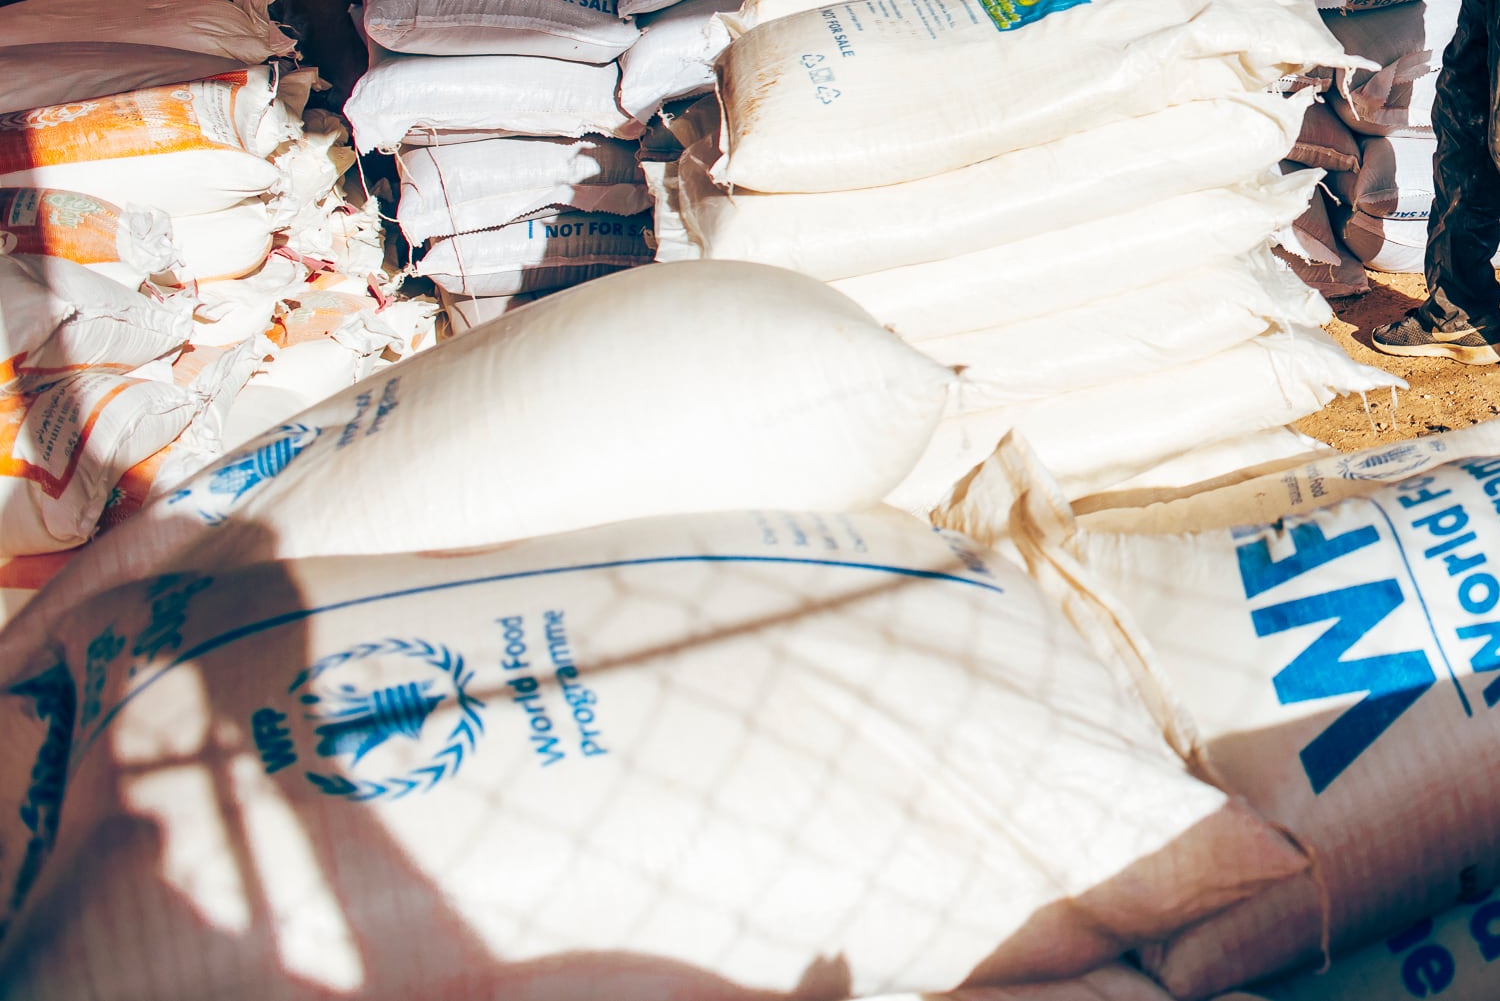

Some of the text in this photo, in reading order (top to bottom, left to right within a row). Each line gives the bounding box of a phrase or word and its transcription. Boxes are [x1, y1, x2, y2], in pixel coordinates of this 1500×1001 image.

[826, 20, 843, 34] FOR
[834, 34, 855, 58] SALE
[546, 222, 584, 238] NOT
[588, 222, 623, 236] FOR
[494, 615, 566, 768] World Food
[543, 610, 610, 756] Programme
[1230, 520, 1436, 795] WF
